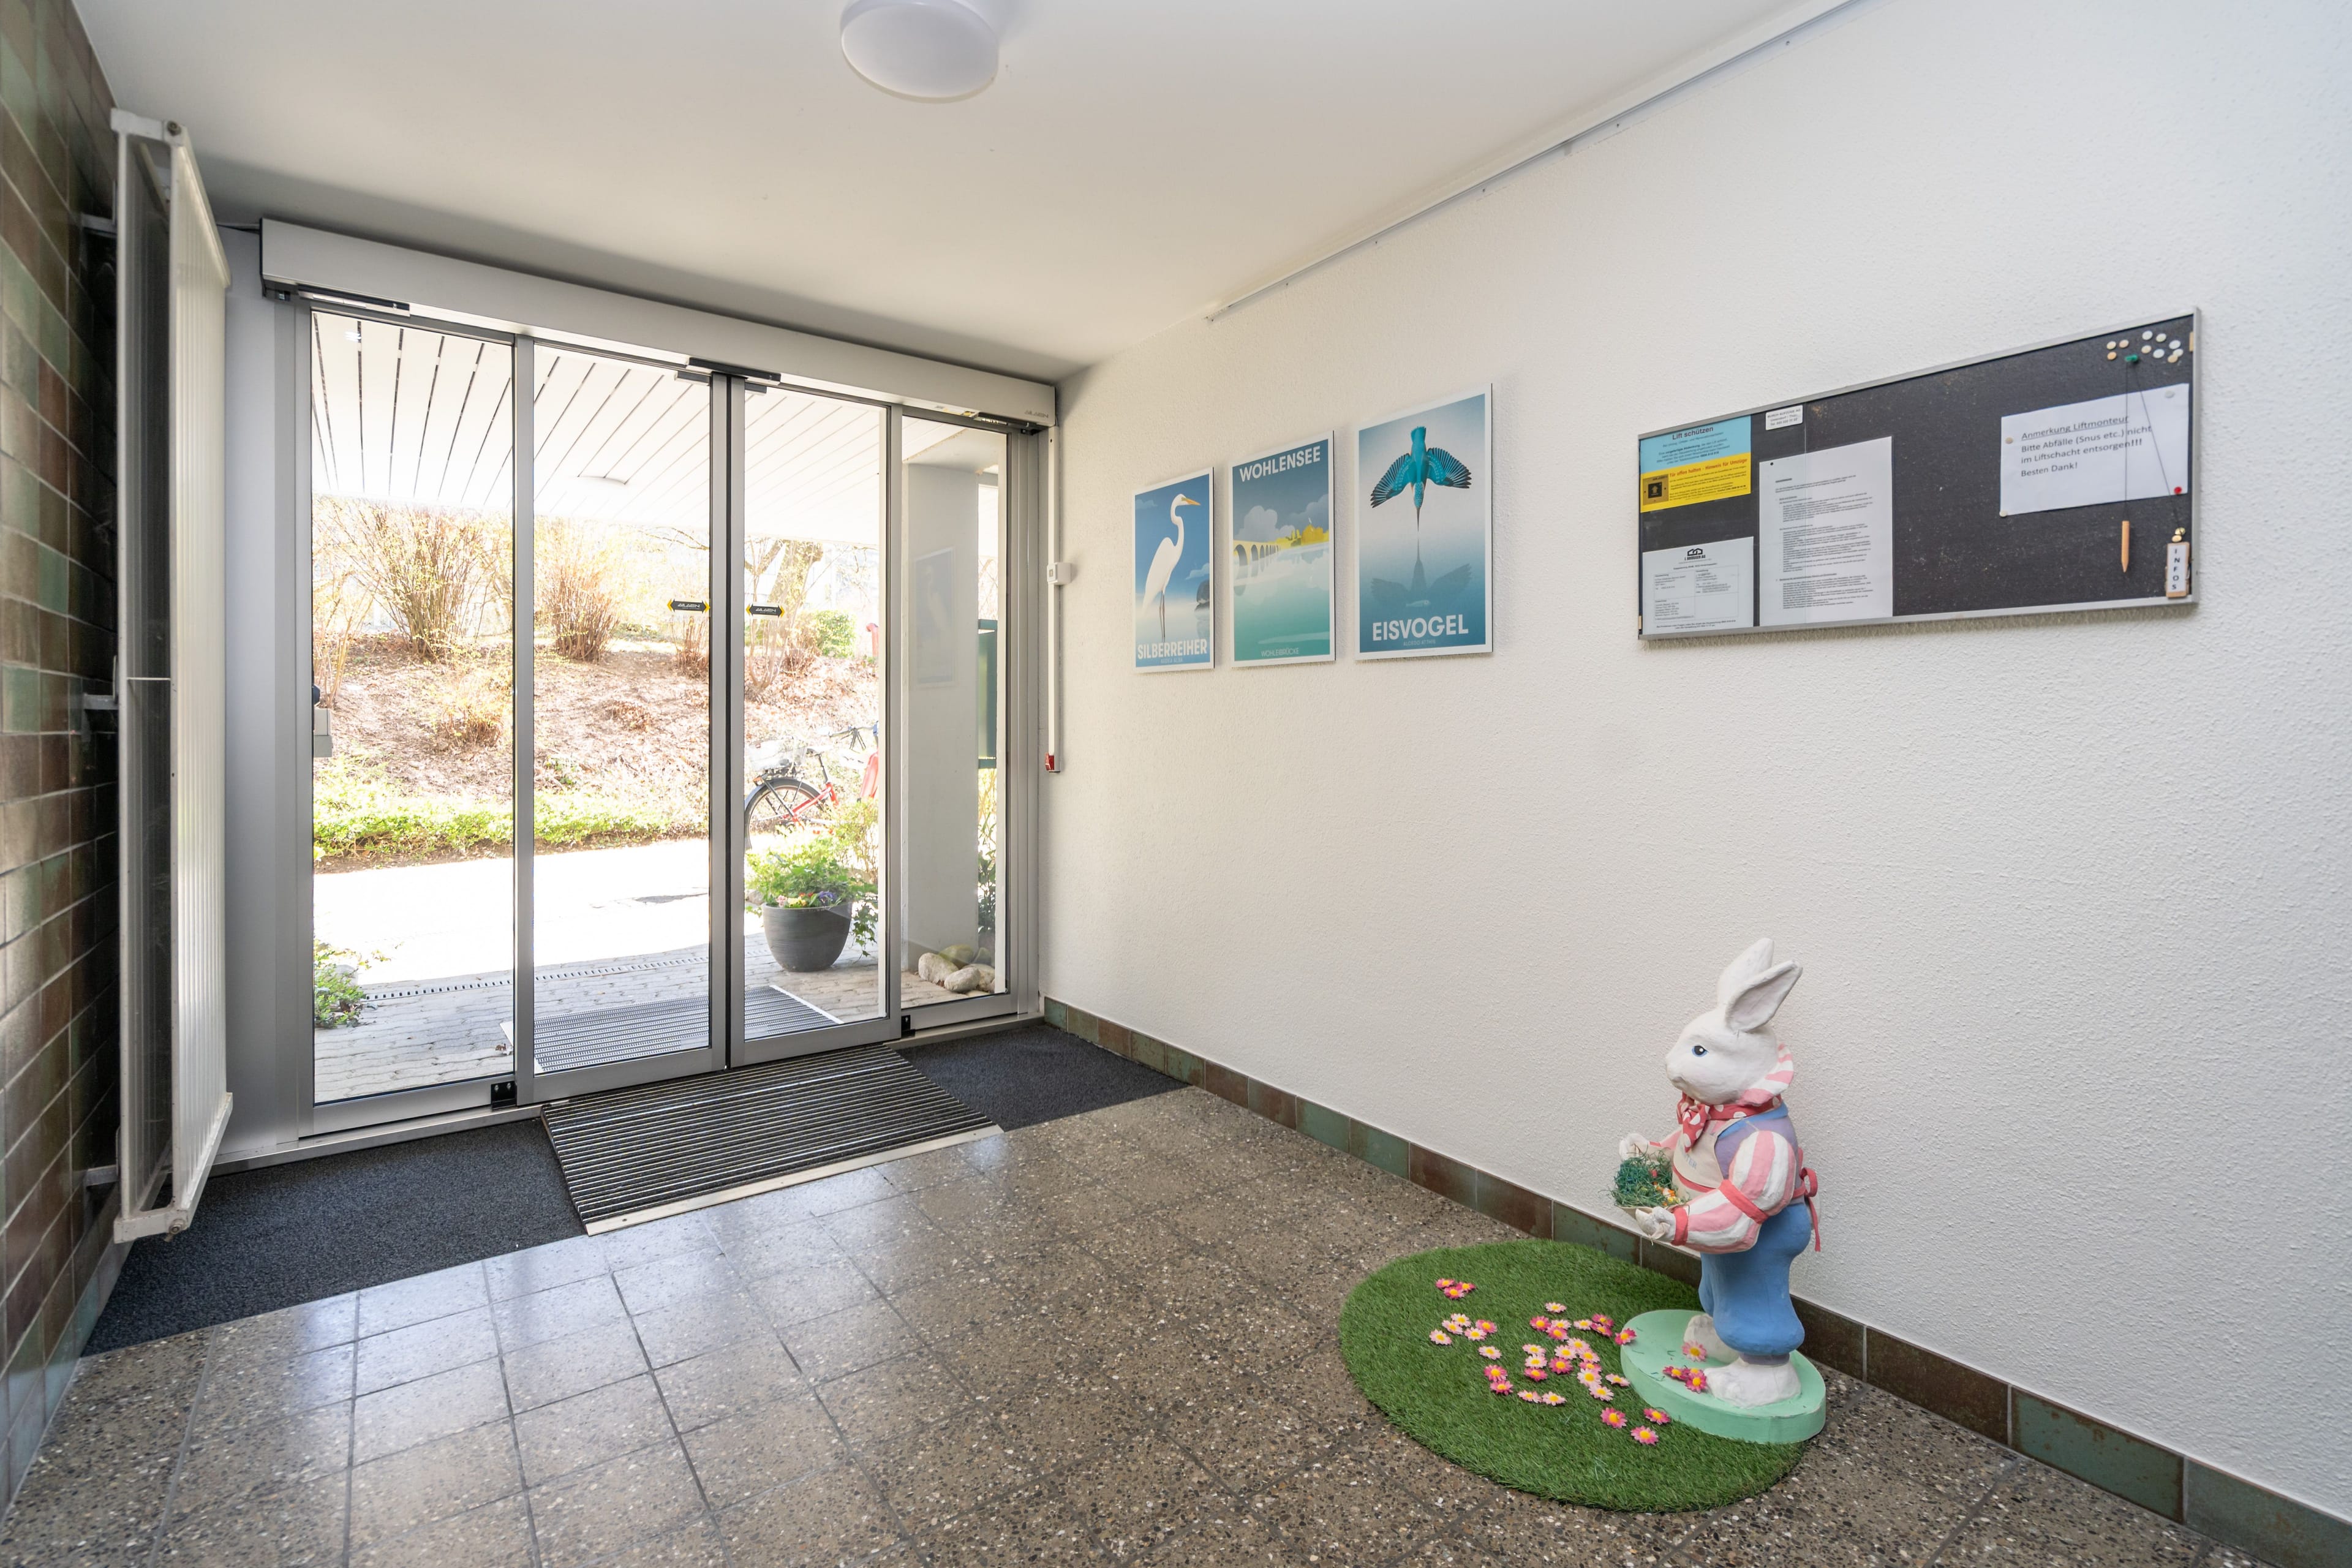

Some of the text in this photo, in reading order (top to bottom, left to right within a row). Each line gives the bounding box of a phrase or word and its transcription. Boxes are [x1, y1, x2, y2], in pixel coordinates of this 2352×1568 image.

[1672, 431, 1683, 440] Lift
[1684, 427, 1714, 437] schützen
[2022, 416, 2129, 440] Anmerkung Liftmonteur
[2022, 426, 2152, 453] Bitte Abfälle (Snus etc.) nicht
[2034, 448, 2080, 462] Liftschacht
[2083, 438, 2143, 454] entsorgen!!!
[1240, 446, 1320, 482] WOHLENSEE
[2021, 462, 2078, 477] Besten Dank!
[1373, 614, 1469, 641] EISVOGEL
[1138, 639, 1207, 659] SILBERREIHER
